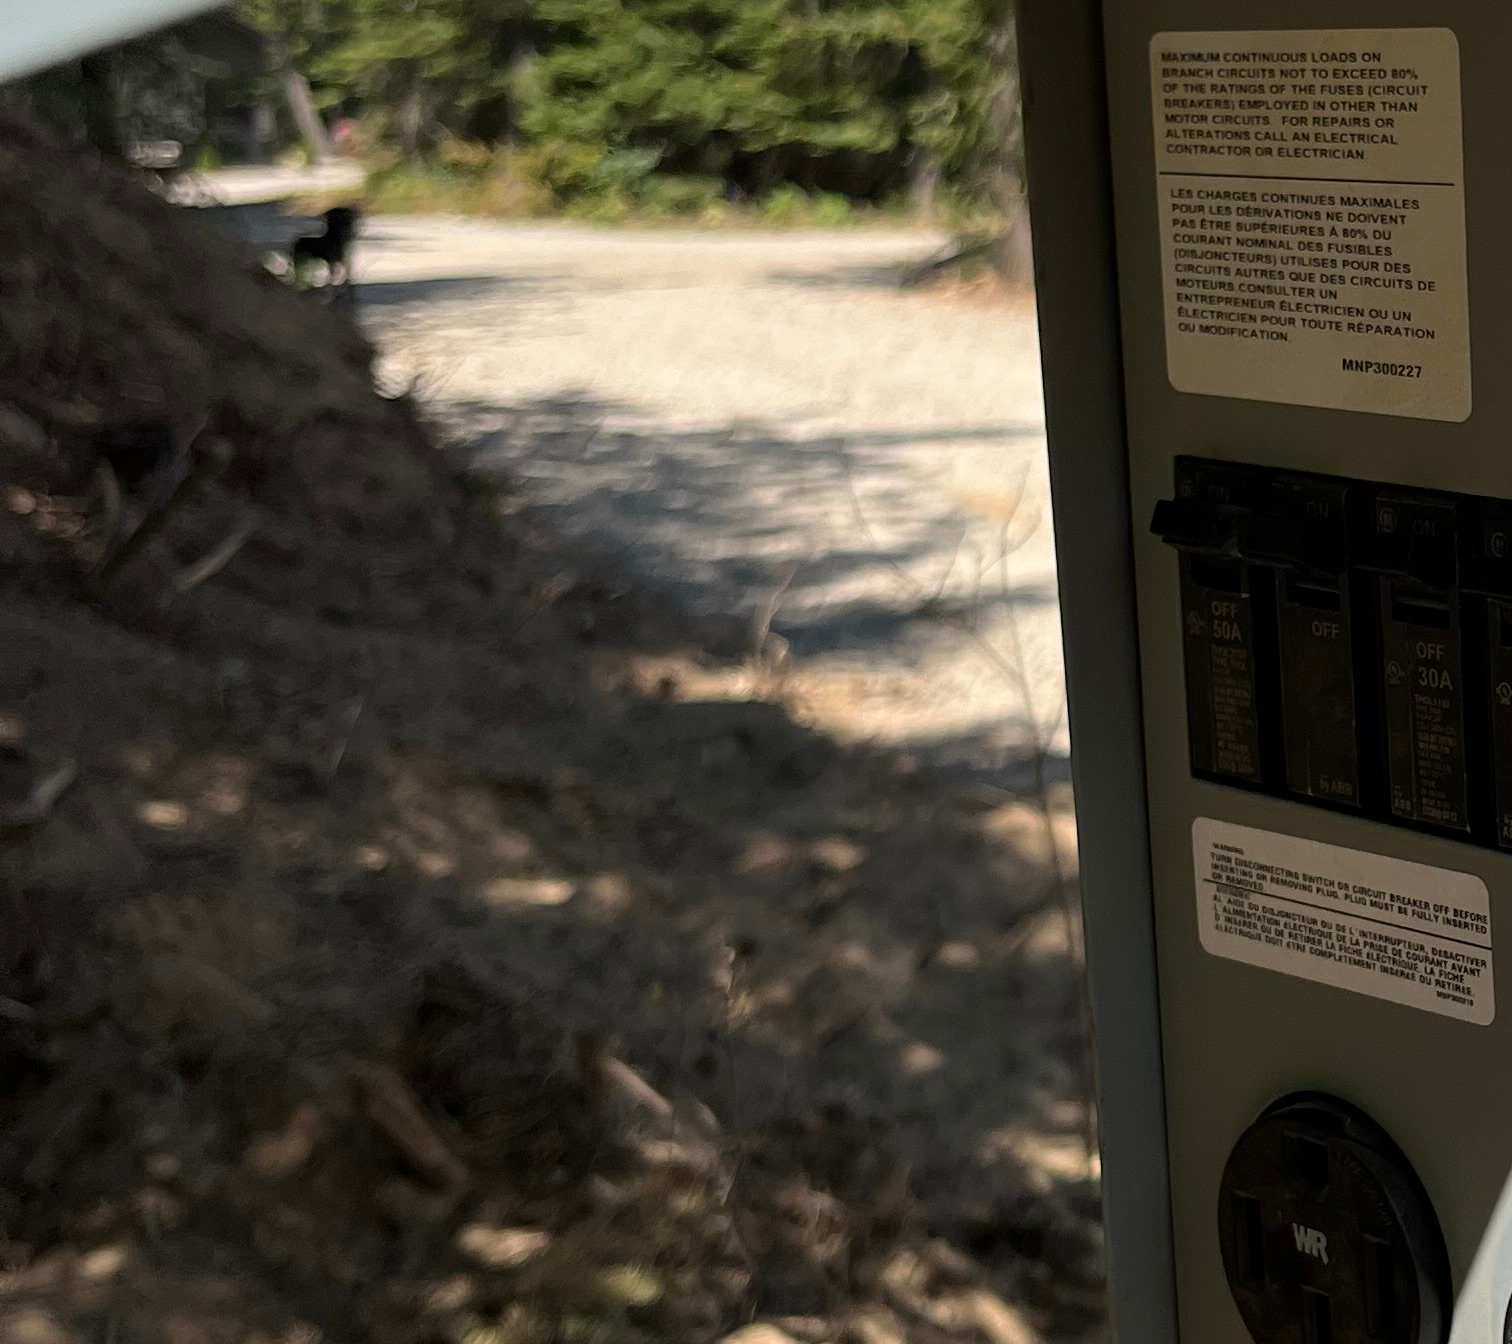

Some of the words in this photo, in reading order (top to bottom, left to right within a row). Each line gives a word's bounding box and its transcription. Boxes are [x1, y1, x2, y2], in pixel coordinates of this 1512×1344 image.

[1161, 52, 1220, 62] MAXIMUM
[1223, 52, 1306, 62] CONTINUOUS
[1311, 52, 1357, 62] LOADS
[1360, 52, 1381, 63] ON
[1161, 67, 1213, 78] BRANCH
[1216, 67, 1275, 78] CIRCUITS
[1279, 67, 1306, 79] NOT
[1310, 68, 1328, 79] TO
[1332, 68, 1387, 79] EXCEED
[1390, 68, 1418, 80] 80%
[1162, 83, 1178, 93] OF
[1183, 83, 1206, 93] THE
[1209, 83, 1265, 94] RATINGS
[1269, 84, 1286, 94] OF
[1291, 84, 1316, 95] THE
[1319, 84, 1364, 95] FUSES
[1367, 84, 1429, 96] (CIRCUIT
[1163, 98, 1235, 109] BREAKERS)
[1238, 99, 1309, 110] EMPLOYED
[1312, 100, 1325, 111] IN
[1329, 100, 1376, 111] OTHER
[1380, 101, 1418, 112] THAN
[1164, 113, 1208, 124] MOTOR
[1211, 114, 1270, 125] CIRCUITS
[1281, 115, 1308, 126] FOR
[1312, 116, 1370, 127] REPAIRS
[1374, 117, 1394, 128] OR
[1164, 128, 1251, 140] ALTERATIONS
[1253, 130, 1288, 141] CALL
[1291, 131, 1310, 142] AN
[1313, 132, 1398, 144] ELECTRICAL
[1165, 143, 1252, 156] CONTRACTOR
[1254, 146, 1272, 157] OR
[1277, 146, 1364, 160] ELECTRICIAN
[1170, 188, 1193, 199] LES
[1196, 189, 1257, 202] CHARGES
[1261, 192, 1336, 206] CONTINUES
[1339, 195, 1420, 210] MAXIMALES
[1171, 203, 1205, 214] POUR
[1208, 204, 1232, 216] LES
[1235, 204, 1321, 221] DÉRIVATIONS
[1325, 210, 1343, 222] NE
[1347, 211, 1406, 225] DOIVENT
[1172, 217, 1196, 229] PAS
[1199, 217, 1231, 231] ÊTRE
[1235, 219, 1325, 236] SUPÉRIEURES
[1328, 224, 1338, 237] À
[1342, 227, 1368, 239] 80%
[1372, 228, 1392, 240] DU
[1172, 232, 1232, 246] COURANT
[1235, 236, 1293, 250] NOMINAL
[1297, 240, 1323, 252] DES
[1327, 242, 1392, 256] FUSIBLES
[1174, 247, 1276, 265] (DISJONCTEURS)
[1280, 254, 1337, 269] UTILISES
[1341, 259, 1379, 272] POUR
[1383, 262, 1411, 274] DES
[1174, 262, 1232, 277] CIRCUITS
[1234, 267, 1285, 281] AUTRES
[1288, 270, 1315, 283] QUE
[1319, 273, 1346, 285] DES
[1350, 275, 1413, 290] CIRCUITS
[1417, 280, 1436, 292] DE
[1175, 277, 1234, 292] MOTEURS
[1237, 282, 1315, 298] CONSULTER
[1319, 288, 1337, 300] UN
[1176, 291, 1275, 310] ENTREPRENEUR
[1279, 298, 1365, 318] ÉLECTRICIEN
[1368, 308, 1388, 319] OU
[1392, 310, 1412, 321] UN
[1176, 304, 1257, 323] ÉLECTRICIEN
[1259, 313, 1296, 327] POUR
[1300, 317, 1346, 332] TOUTE
[1346, 319, 1435, 340] RÉPARATION
[1177, 322, 1195, 333] OU
[1198, 324, 1288, 342] MODIFICATION
[1342, 358, 1423, 379] MNP300227
[1211, 601, 1239, 619] OFF
[1213, 620, 1242, 641] 50A
[1311, 621, 1340, 639] OFF
[1415, 642, 1445, 660] OFF
[1418, 666, 1453, 691] 30A
[1209, 851, 1232, 864] TURN
[1302, 872, 1335, 888] SWITCH
[1337, 880, 1349, 892] OR
[1352, 884, 1386, 900] CIRCUIT
[1389, 892, 1430, 911] BREAKER
[1432, 902, 1449, 915] OFF
[1453, 907, 1488, 925] BEFORE
[1255, 872, 1267, 882] OR
[1269, 875, 1313, 893] REMOVING
[1343, 892, 1366, 906] PLUG
[1369, 898, 1394, 912] MUST
[1397, 905, 1408, 916] BE
[1411, 908, 1439, 923] FULLY
[1442, 915, 1487, 935] INSERTED
[1293, 1222, 1329, 1265] WR
